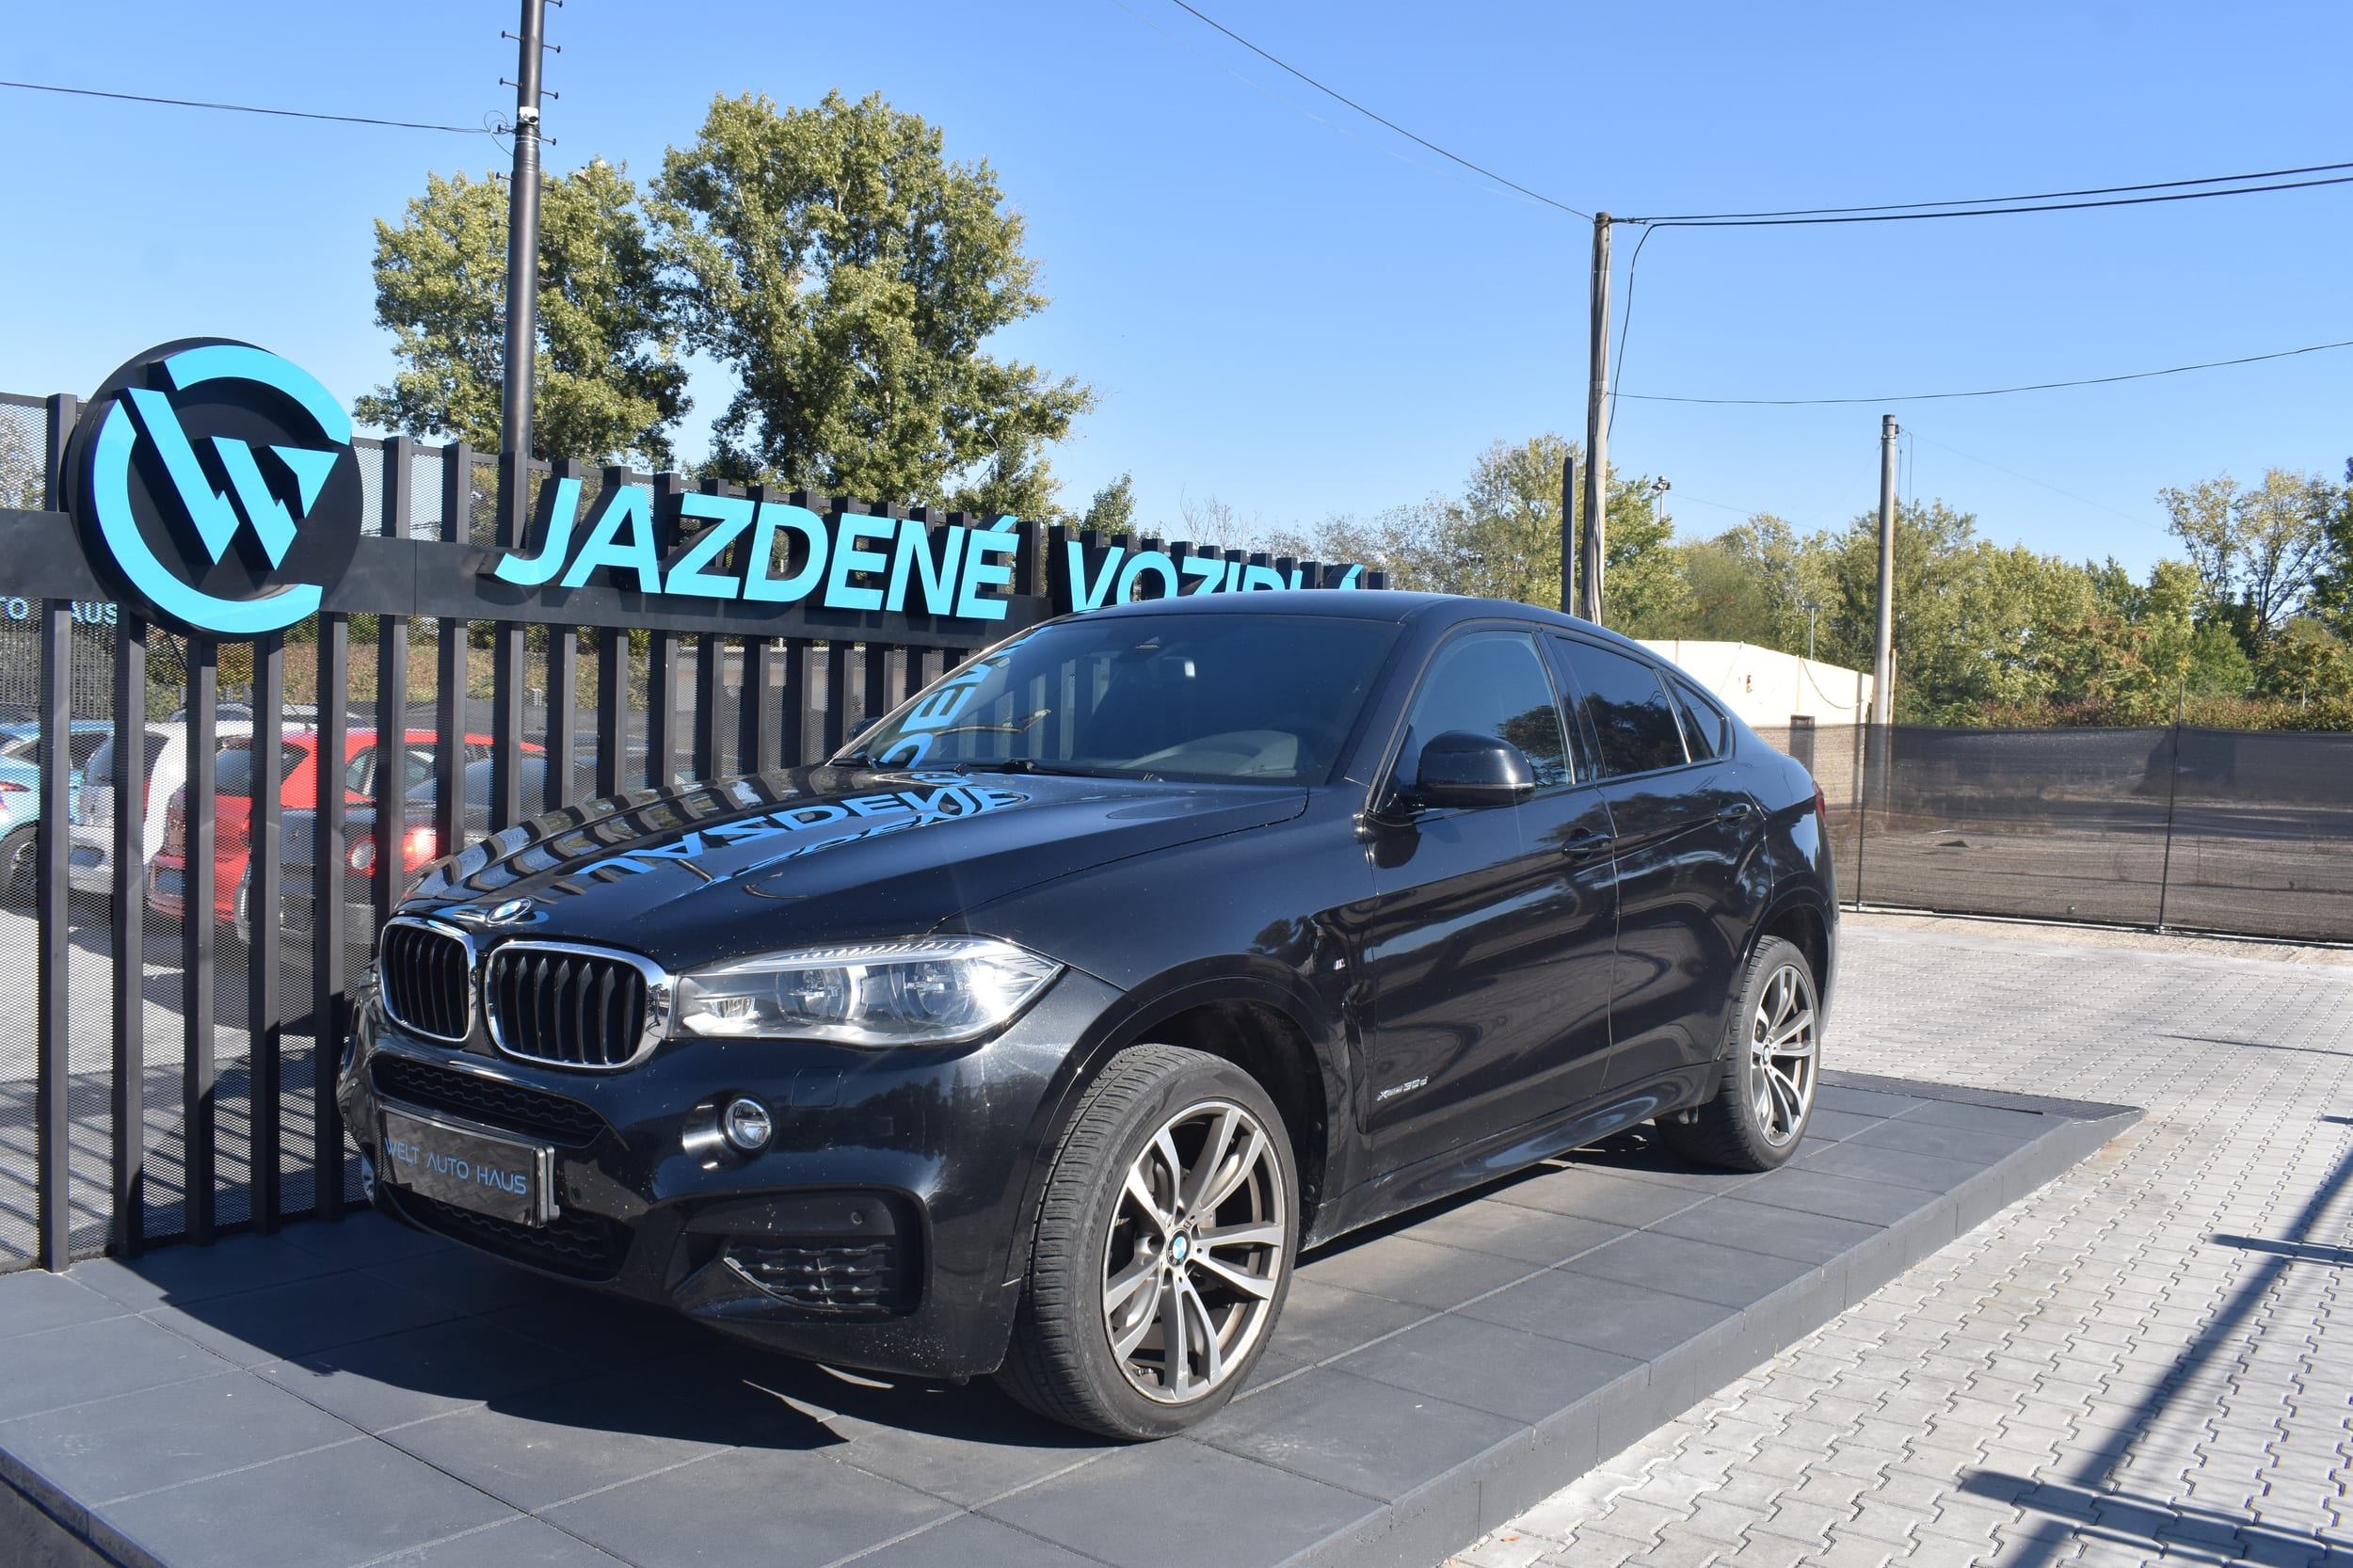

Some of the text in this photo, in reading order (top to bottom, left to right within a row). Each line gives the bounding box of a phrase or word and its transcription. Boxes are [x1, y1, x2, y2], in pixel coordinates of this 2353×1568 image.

[494, 478, 1019, 620] JAZDENÉ
[384, 1136, 528, 1195] WELT AUTO HAUS
